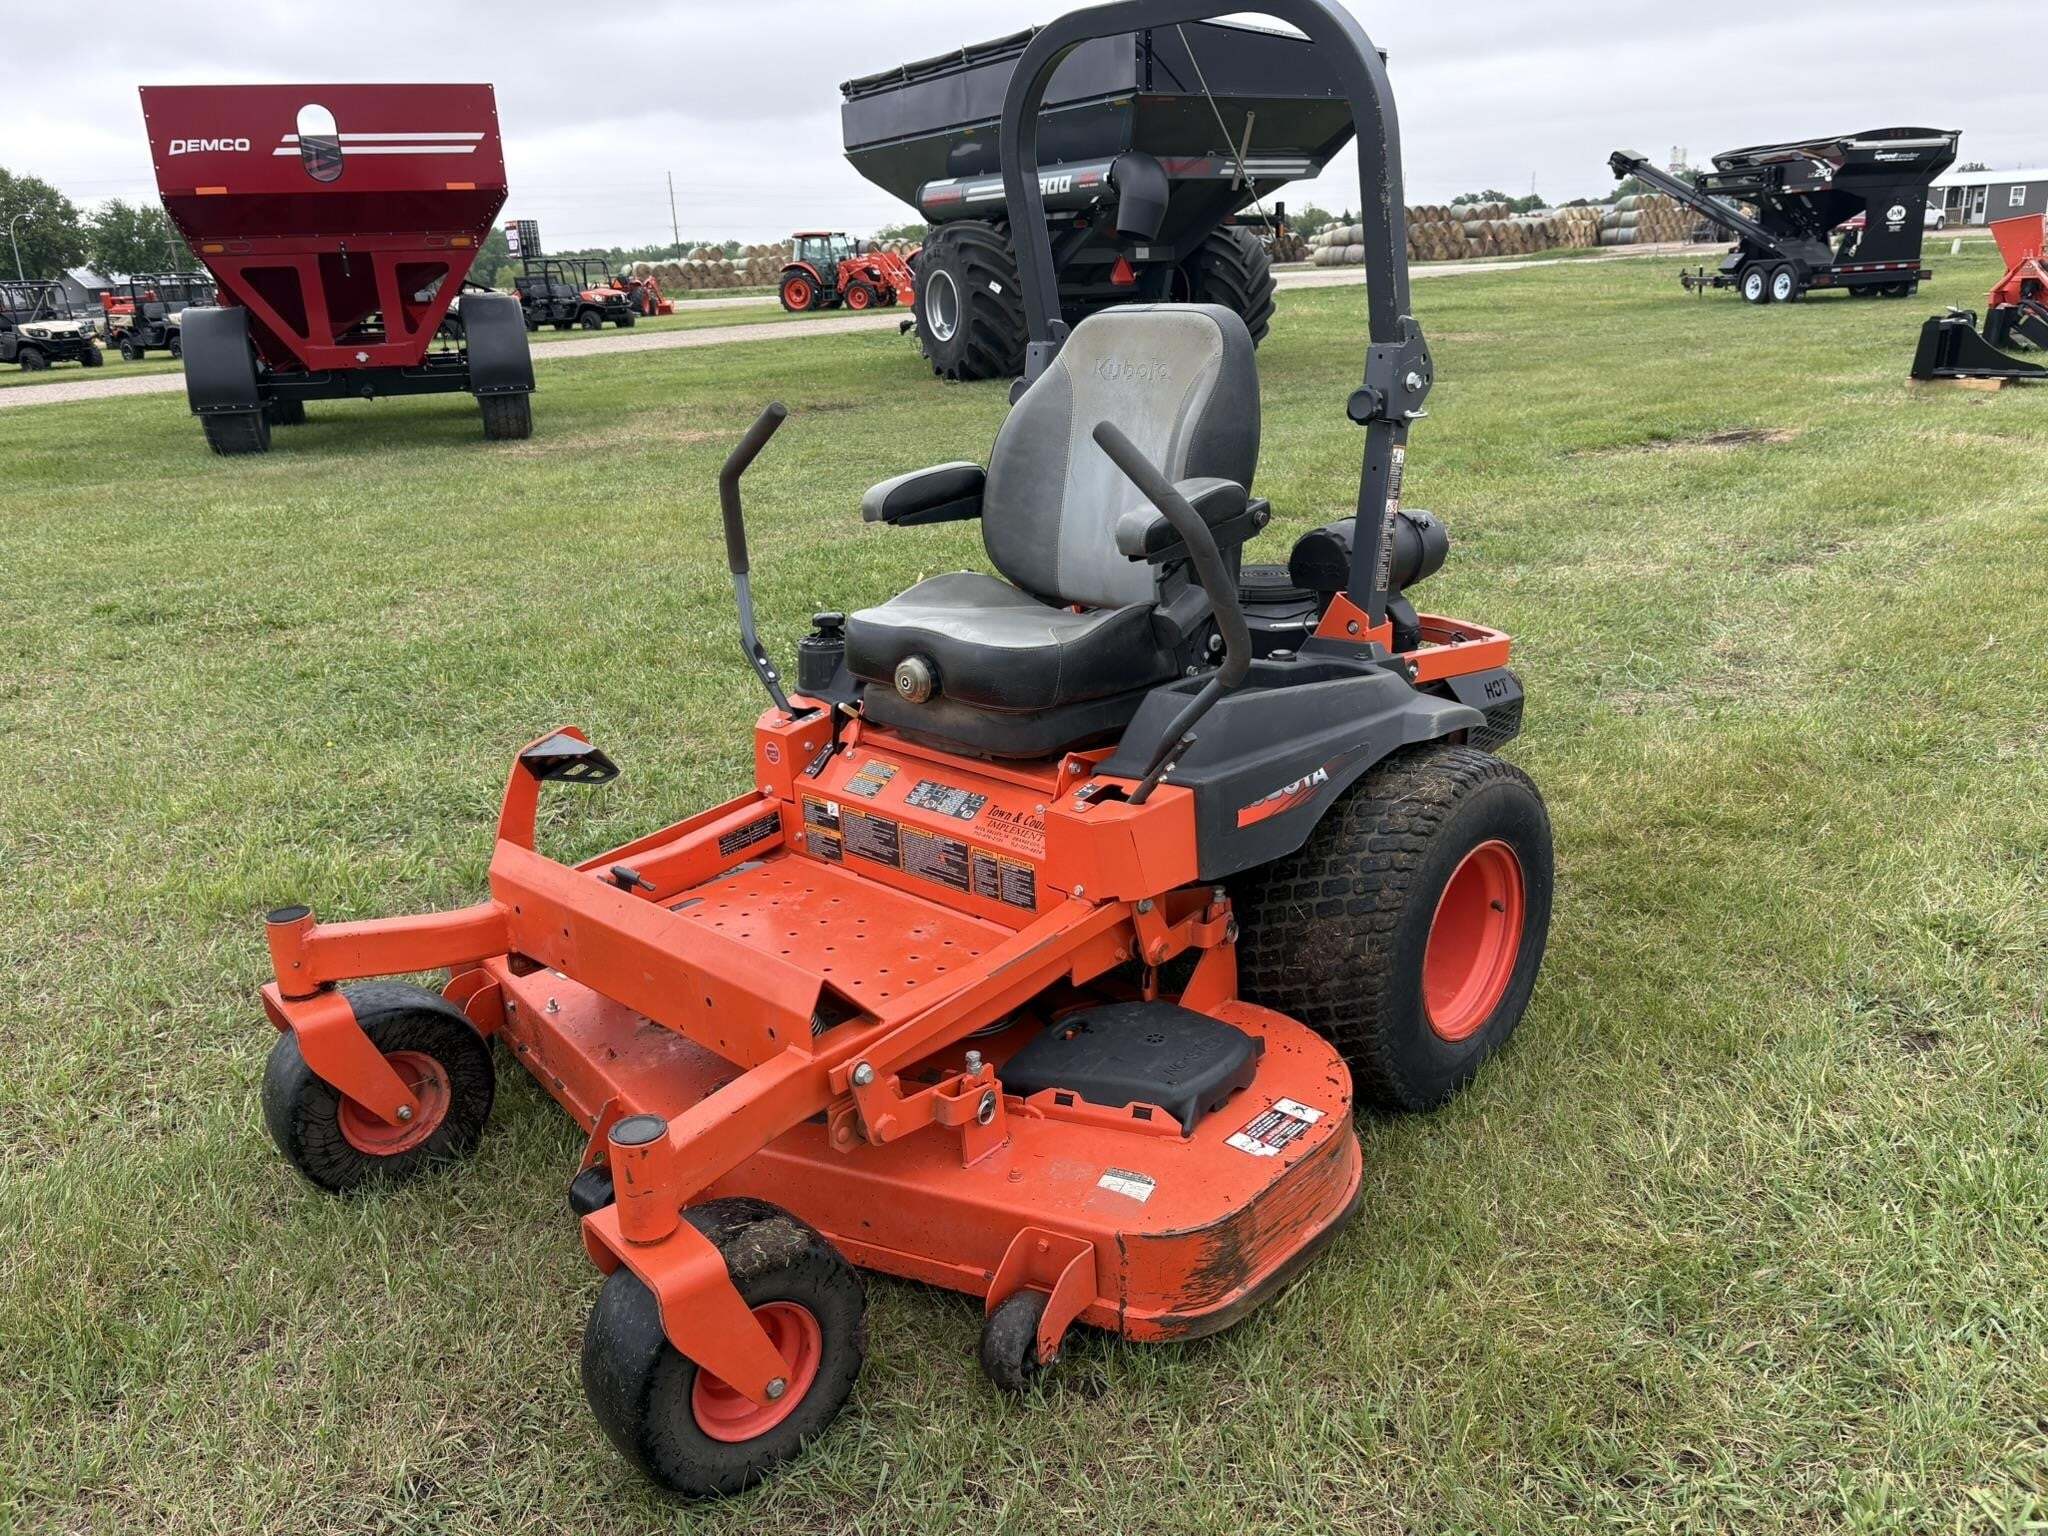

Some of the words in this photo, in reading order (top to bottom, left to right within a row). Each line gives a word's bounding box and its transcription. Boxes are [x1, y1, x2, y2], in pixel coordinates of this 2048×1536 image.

[168, 138, 250, 156] DEMCO
[1483, 677, 1508, 700] HOT
[987, 805, 1012, 821] Town
[1012, 811, 1024, 824] &
[987, 820, 1046, 842] IMPLEMENT
